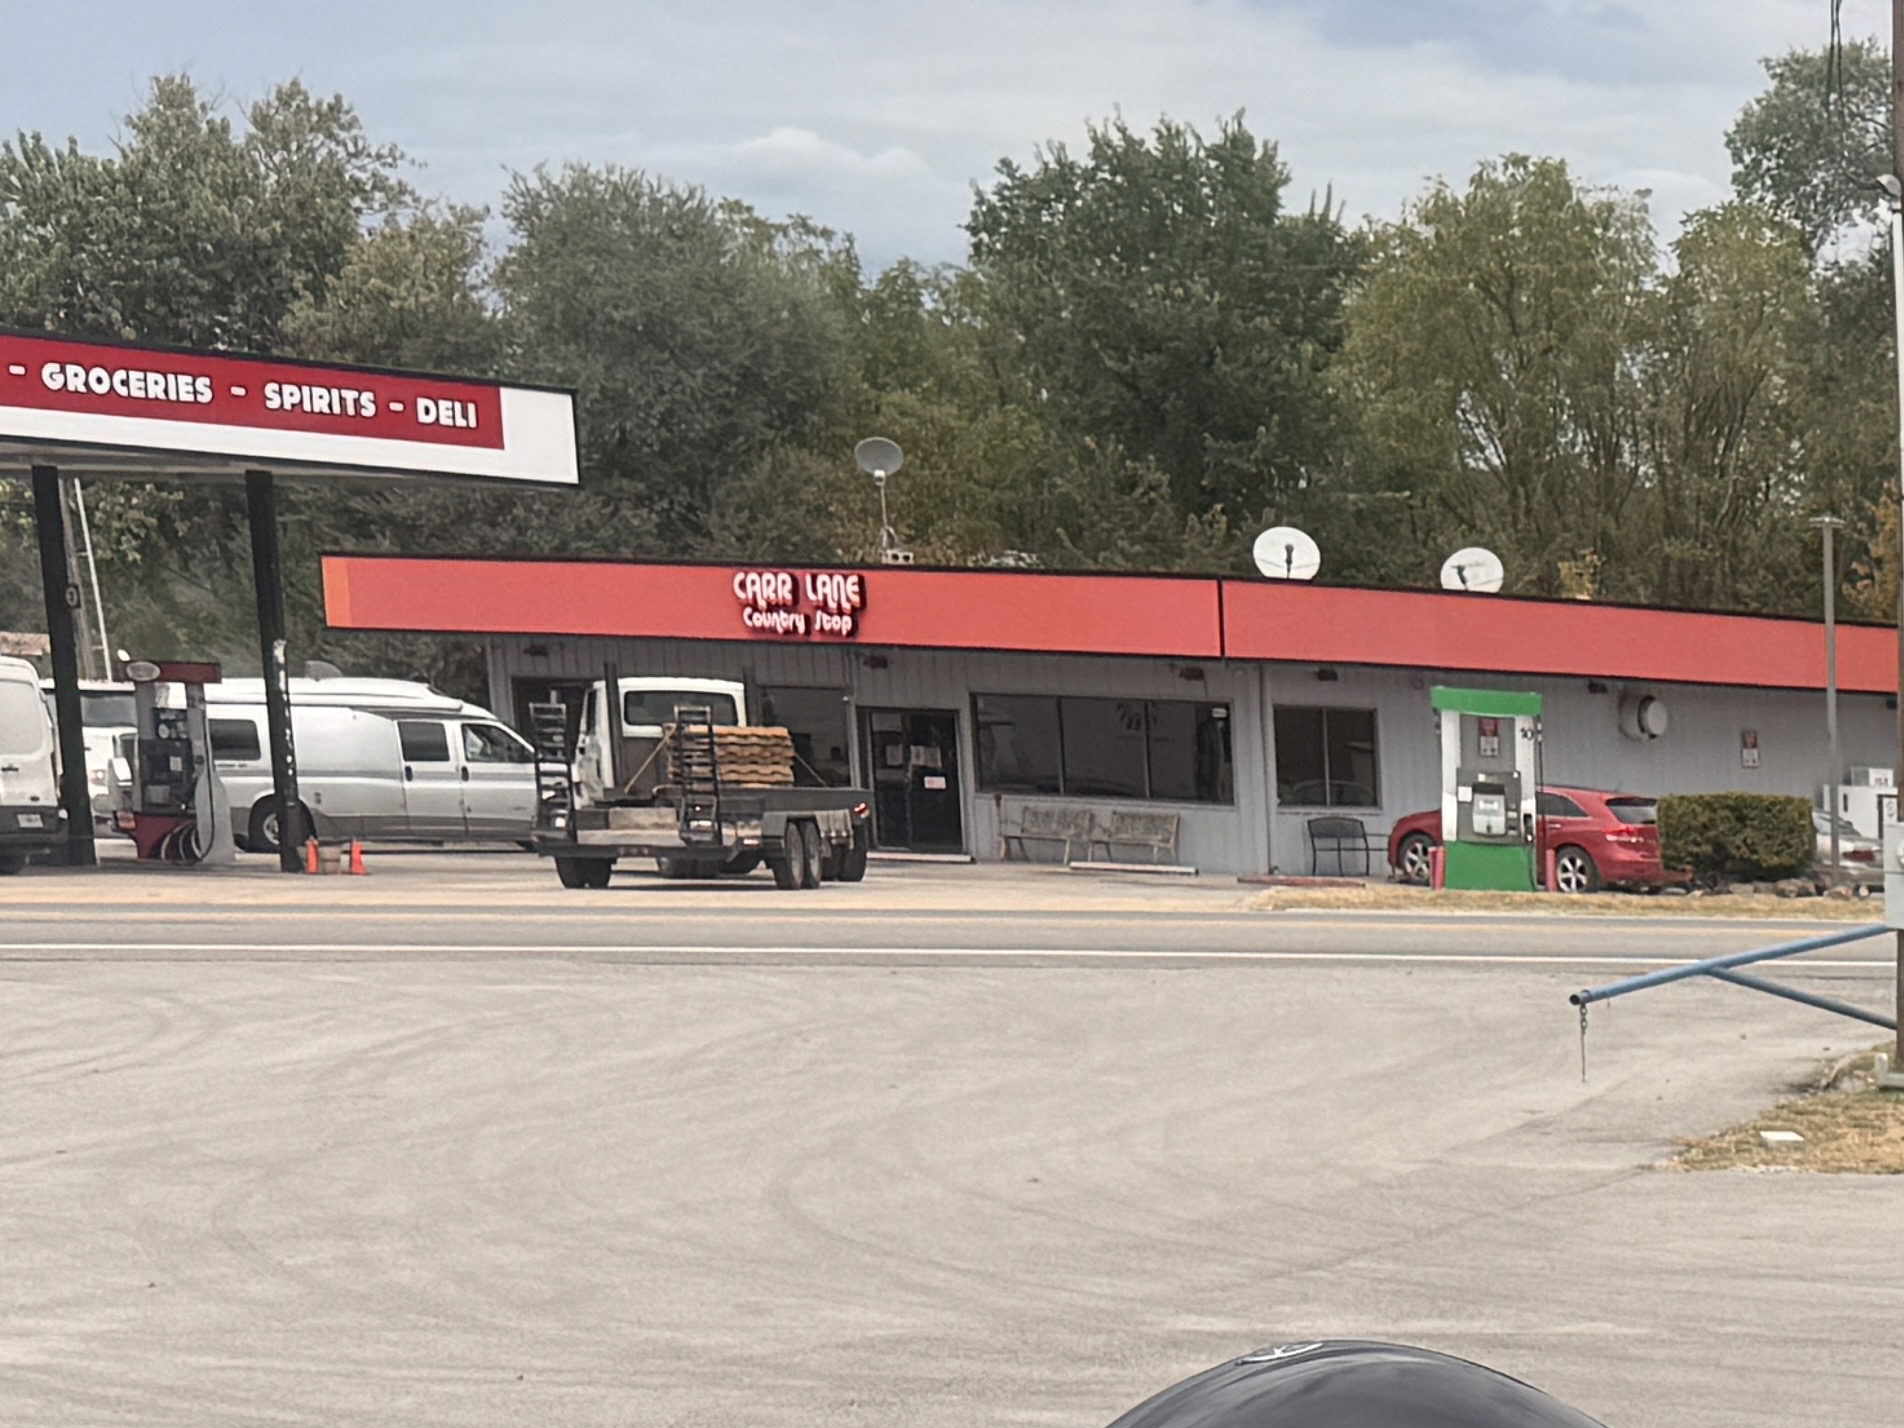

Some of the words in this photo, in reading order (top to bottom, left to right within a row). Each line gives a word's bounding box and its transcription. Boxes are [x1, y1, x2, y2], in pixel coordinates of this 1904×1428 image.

[41, 361, 213, 404] GROCERIES
[264, 381, 377, 418] SPIRITS
[415, 396, 479, 428] DELI
[733, 571, 794, 611] CARR
[804, 572, 861, 614] LANE
[743, 605, 806, 635] Country
[814, 609, 853, 637] Stop
